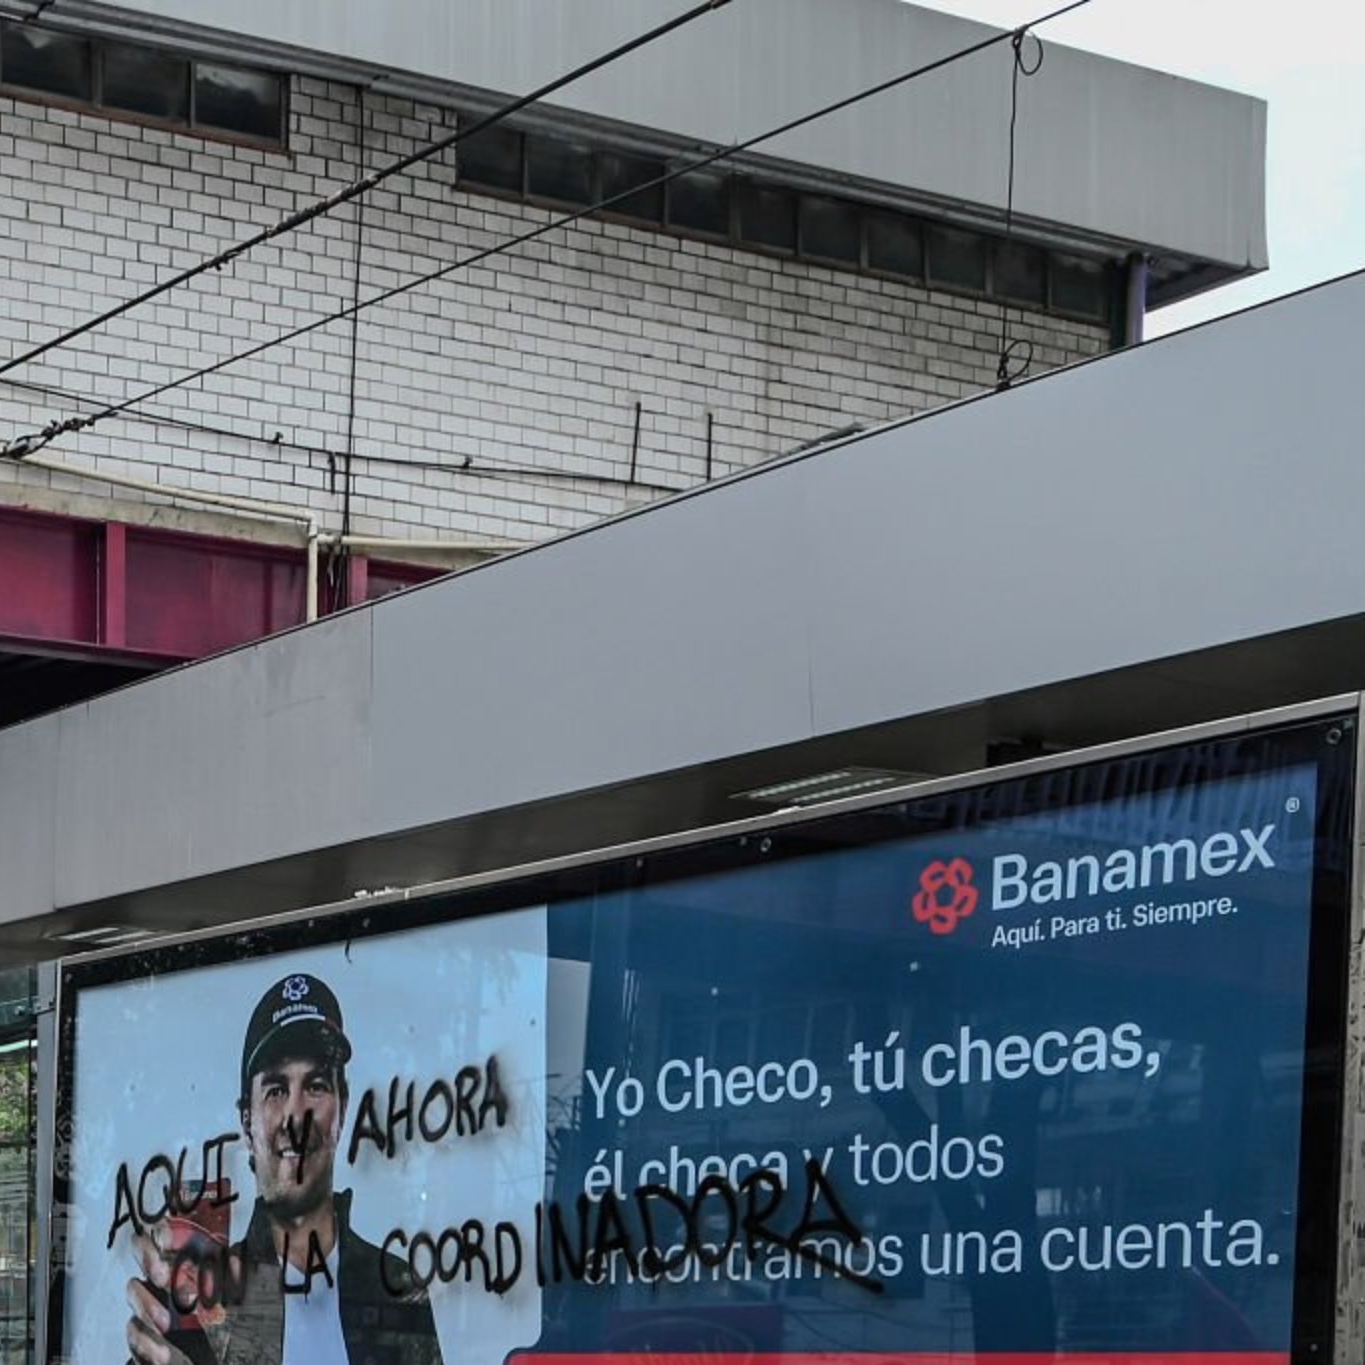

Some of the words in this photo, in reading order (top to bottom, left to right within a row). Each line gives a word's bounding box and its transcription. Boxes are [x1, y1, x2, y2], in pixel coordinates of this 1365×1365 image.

[990, 821, 1277, 910] Banamex
[990, 921, 1046, 950] Aquí.
[1051, 912, 1101, 938] Para
[1106, 908, 1127, 934] ti.
[1133, 894, 1239, 935] Siempre.
[585, 1067, 643, 1120] Yo
[656, 1057, 832, 1113] Checo,
[848, 1028, 905, 1096] tú
[922, 1018, 1162, 1089] checas,
[107, 1131, 241, 1249] AQUI
[283, 1107, 314, 1186] Y
[347, 1054, 509, 1165] AHORA
[584, 1148, 626, 1204] él
[643, 1143, 789, 1198] checa
[848, 1125, 1006, 1187] todos
[281, 1230, 334, 1296] LA
[380, 1158, 883, 1300] COORDINADORA
[583, 1228, 904, 1286] encontramos
[921, 1230, 1024, 1279] una
[1040, 1208, 1281, 1274] cuenta.
